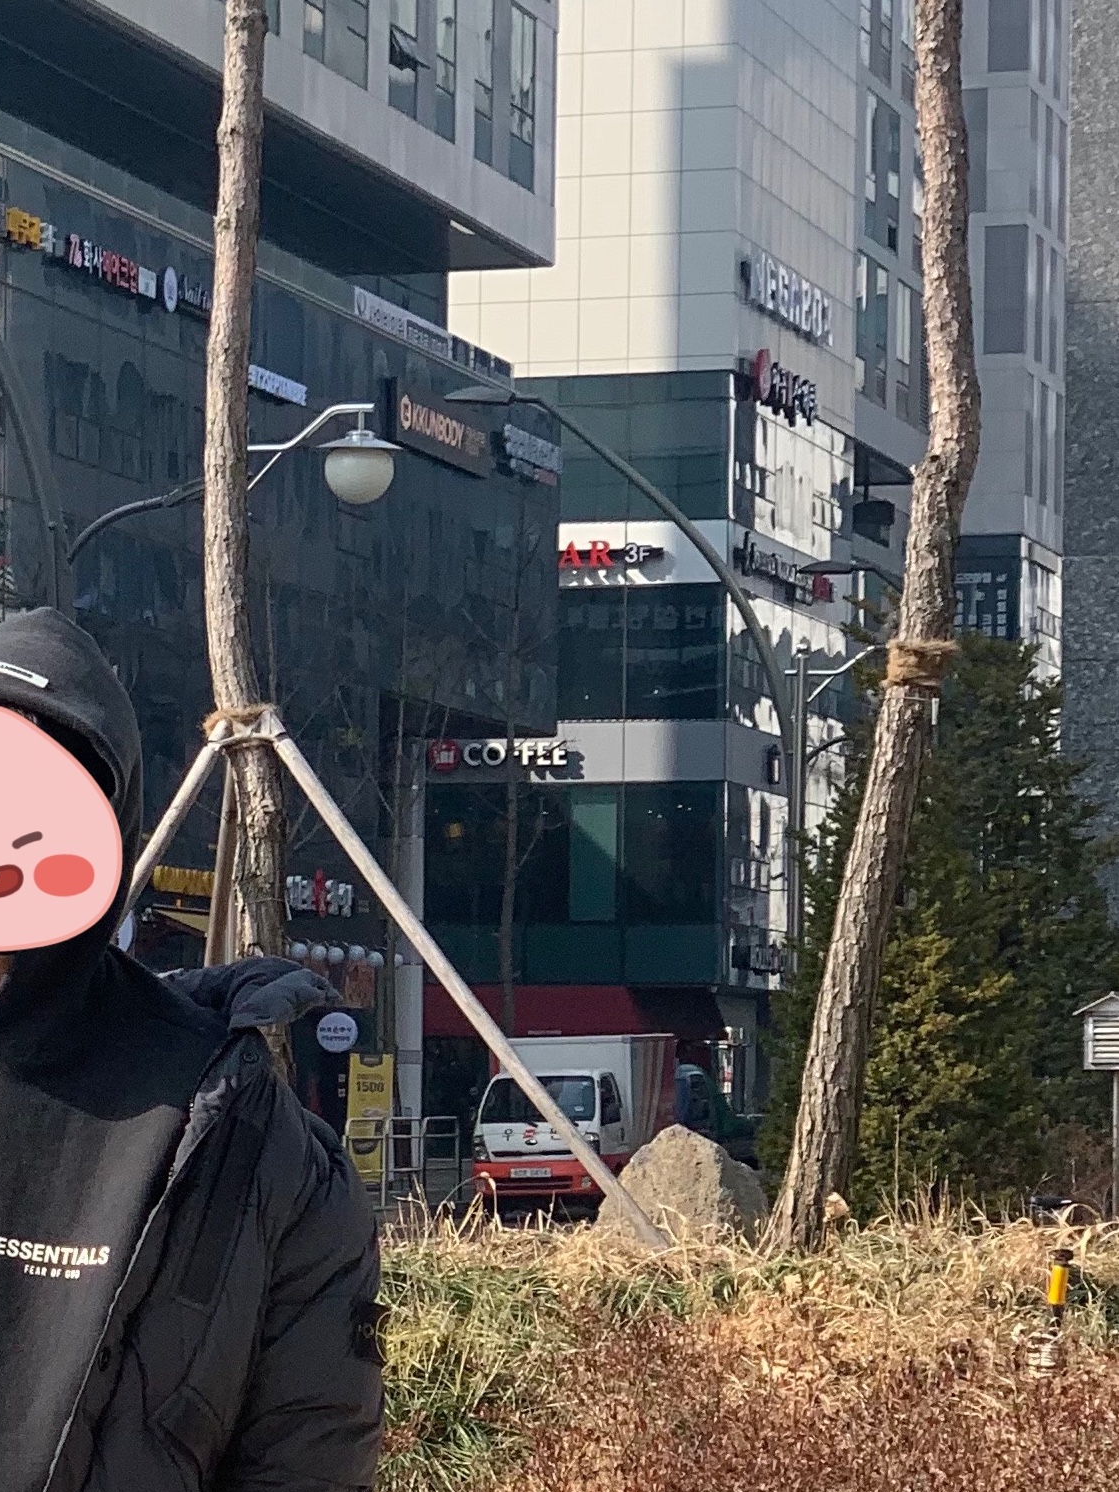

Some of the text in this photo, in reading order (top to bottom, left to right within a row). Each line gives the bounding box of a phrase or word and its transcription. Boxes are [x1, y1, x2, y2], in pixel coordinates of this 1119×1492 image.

[624, 542, 651, 563] 3F
[24, 1264, 47, 1277] FEAR
[50, 1268, 61, 1278] OF
